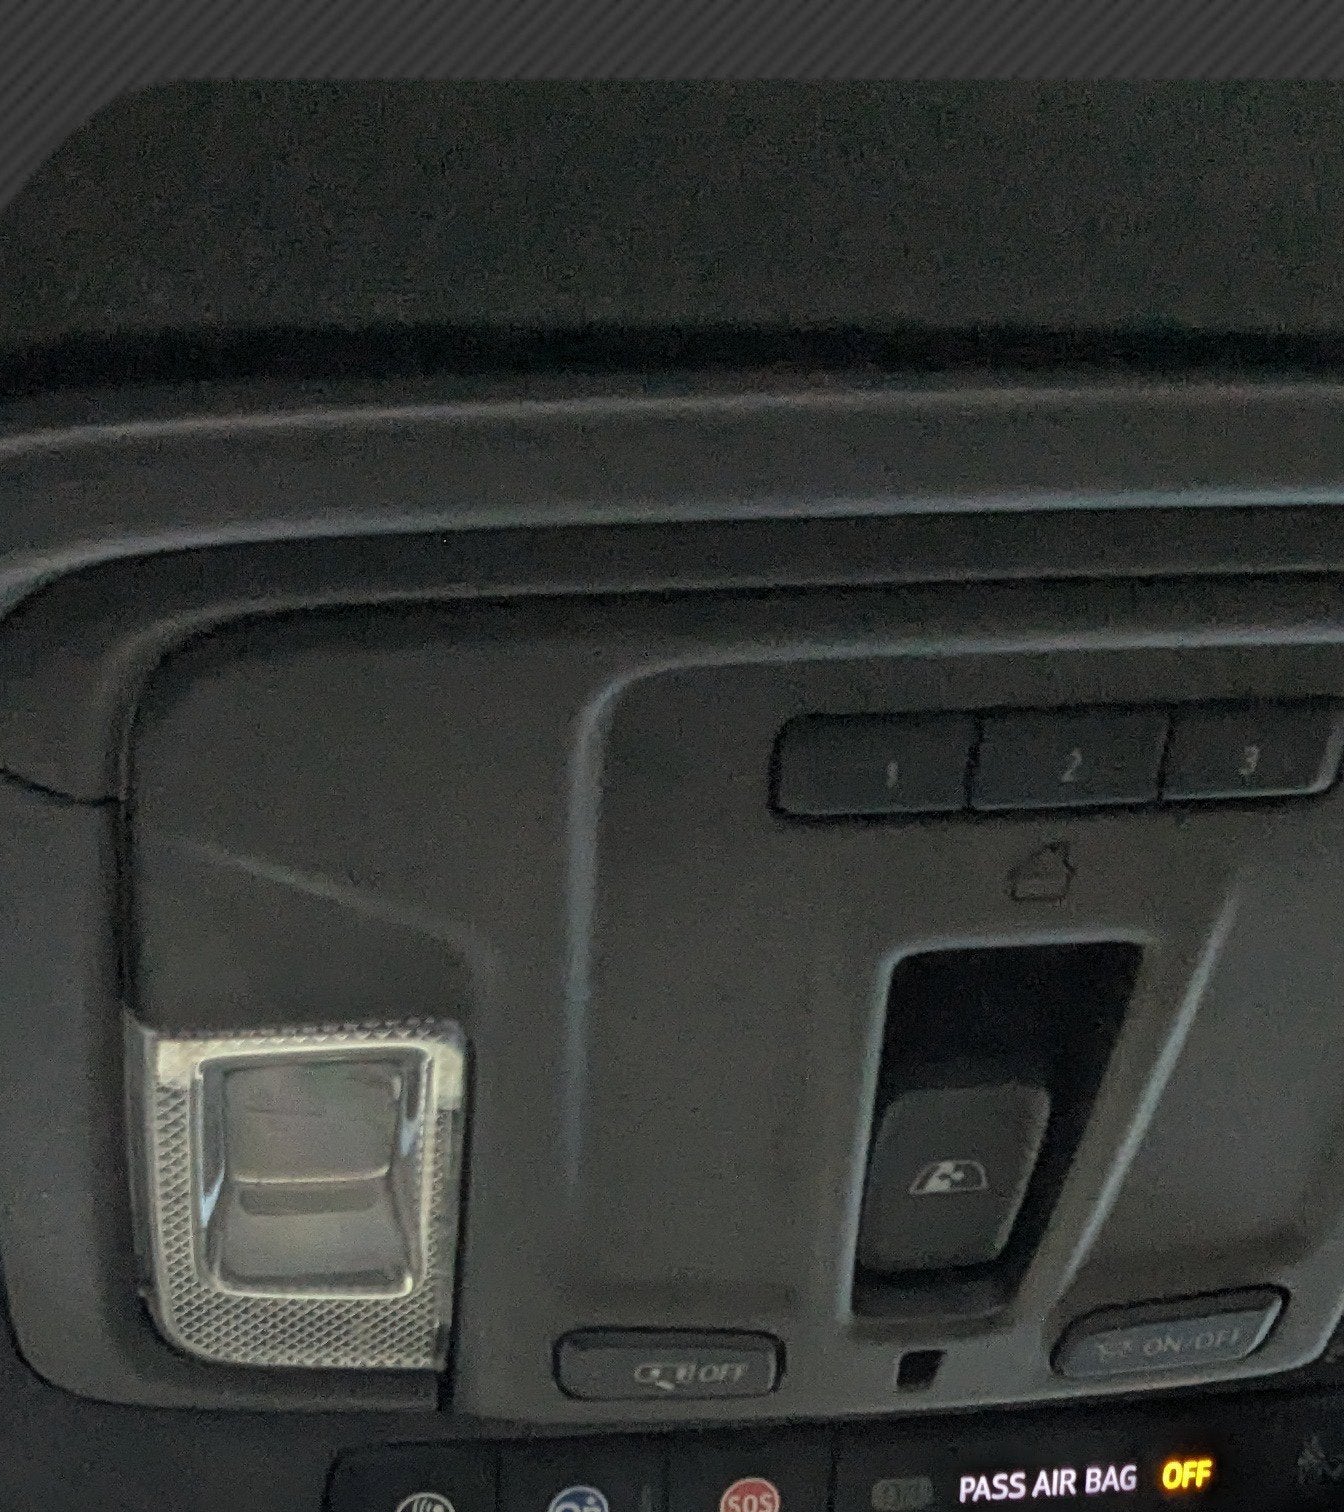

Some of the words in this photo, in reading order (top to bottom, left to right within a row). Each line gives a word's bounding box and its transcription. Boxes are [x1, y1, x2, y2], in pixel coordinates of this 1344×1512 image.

[885, 761, 899, 787] 1
[1059, 748, 1083, 782] 2
[1239, 744, 1261, 776] 3
[959, 1471, 1026, 1503] PASS
[1030, 1468, 1077, 1497] AIR
[1084, 1464, 1138, 1492] BAG
[1162, 1459, 1213, 1490] OFF
